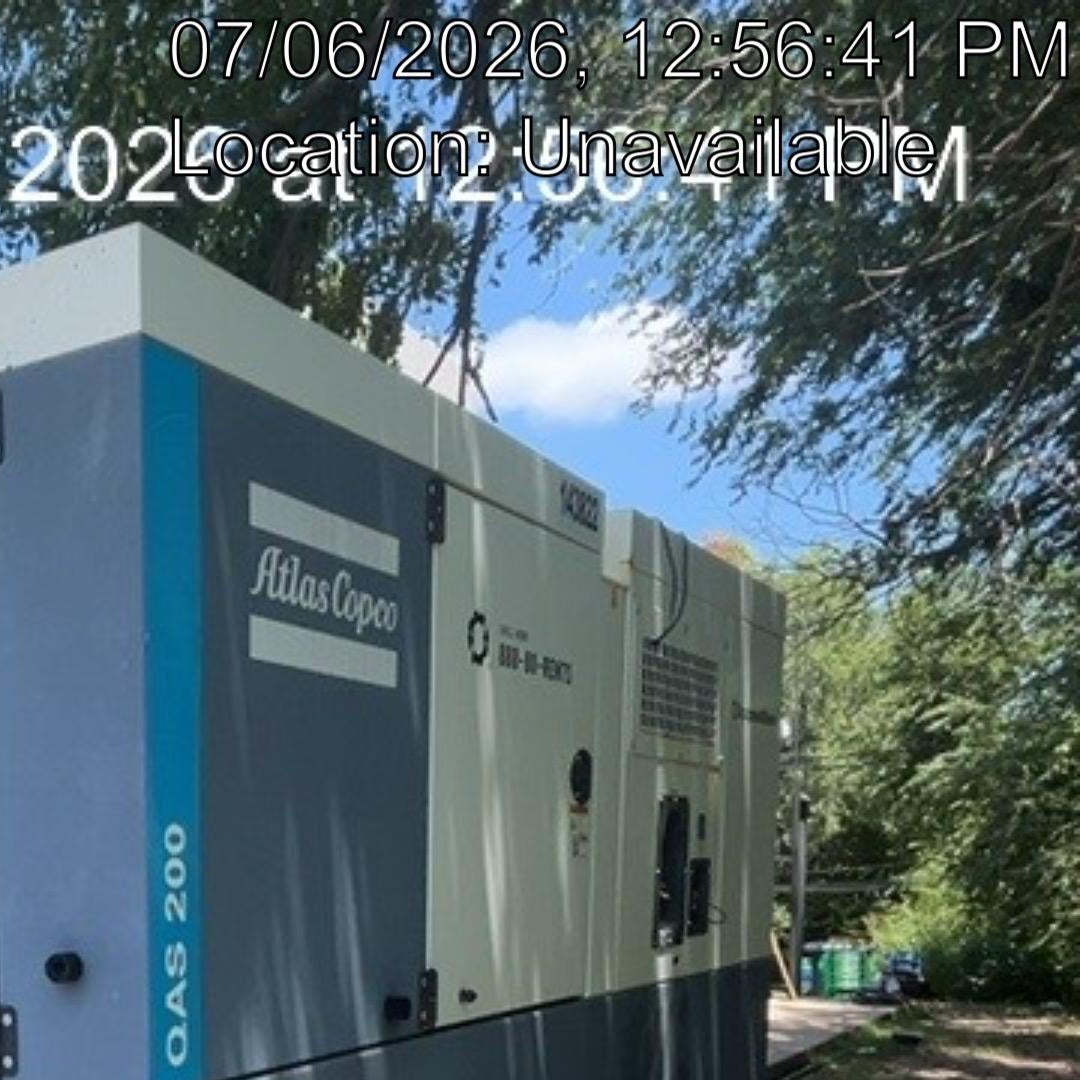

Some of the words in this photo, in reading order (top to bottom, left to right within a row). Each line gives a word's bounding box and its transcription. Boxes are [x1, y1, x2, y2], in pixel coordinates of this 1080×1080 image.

[249, 545, 331, 614] Atlas
[332, 569, 399, 635] Copco
[163, 823, 187, 922] 200
[164, 942, 188, 1068] QAS
